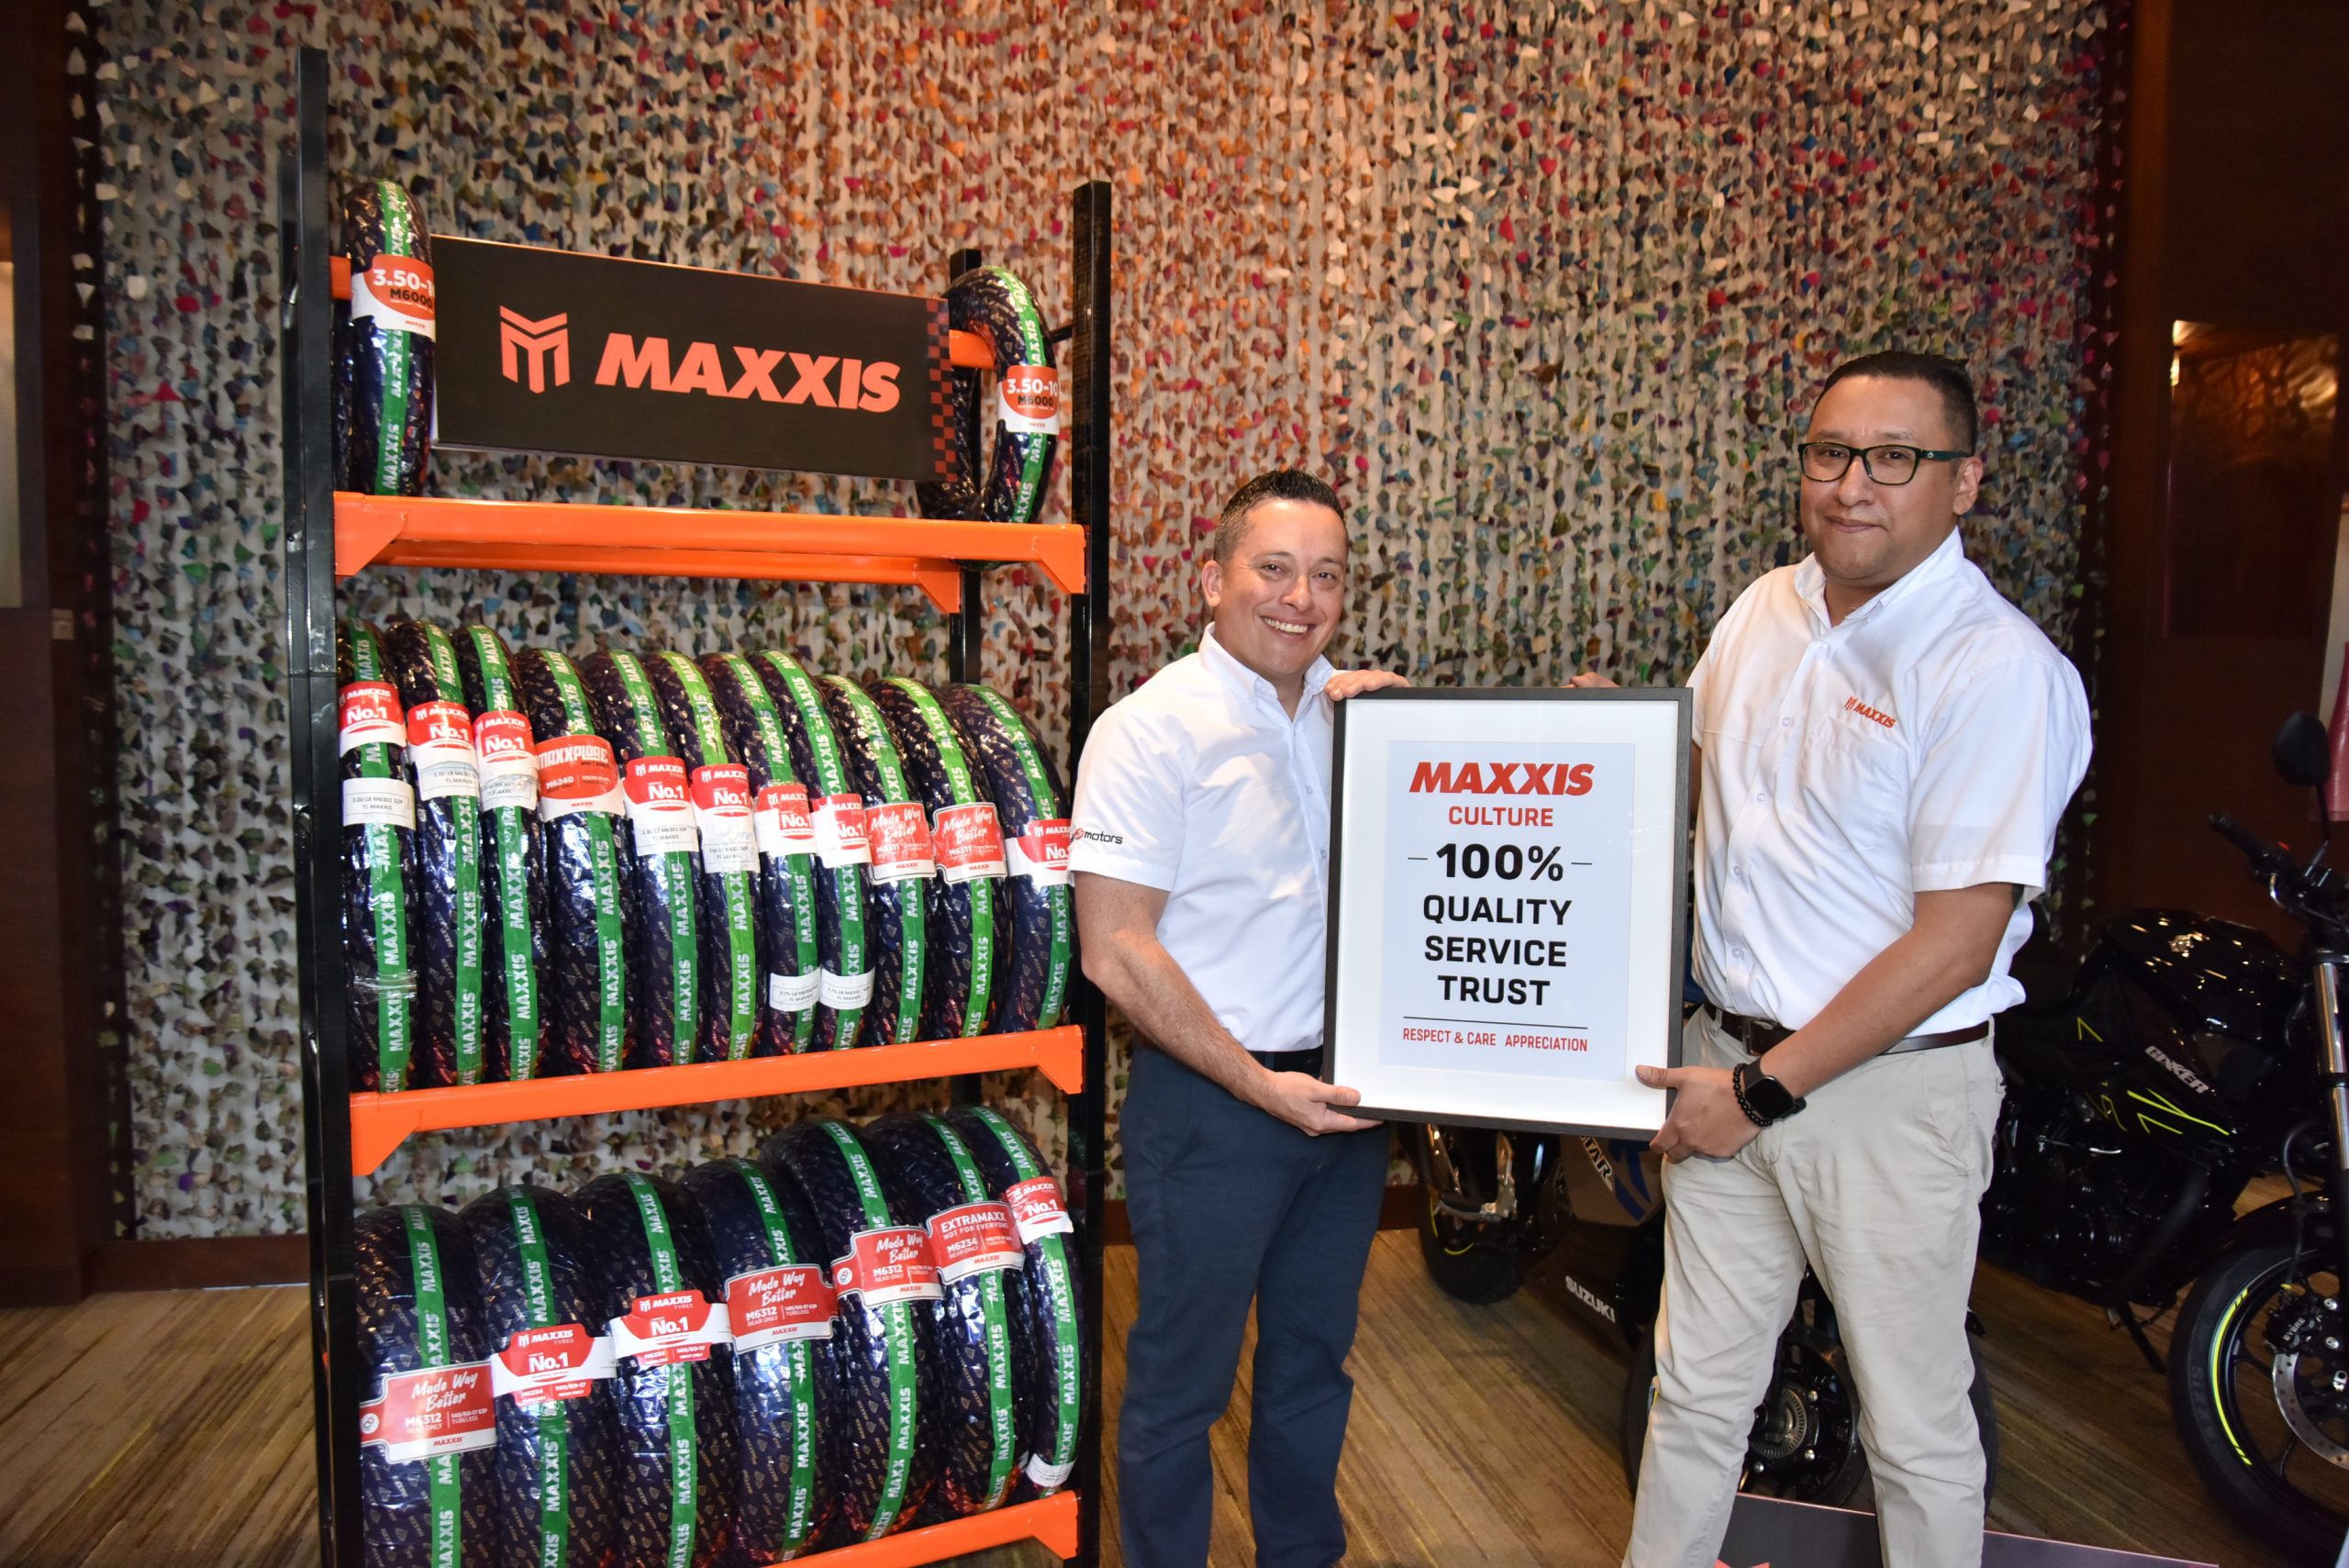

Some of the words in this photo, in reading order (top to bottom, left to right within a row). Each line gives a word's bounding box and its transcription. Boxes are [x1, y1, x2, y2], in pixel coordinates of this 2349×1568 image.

[373, 269, 435, 297] 3.50-1
[390, 287, 433, 309] M6000
[595, 333, 900, 414] MAXXIS
[1007, 378, 1059, 397] 3.50-10
[1018, 395, 1054, 407] M6000
[382, 422, 400, 490] MAXXIS
[1015, 482, 1034, 523] AXXIS
[347, 688, 392, 700] MAXXIS
[347, 706, 388, 725] No.1
[485, 717, 526, 728] MAXXIS
[1854, 702, 1897, 728] MAXXIS
[429, 723, 470, 741] No.1
[484, 736, 526, 753] No.1
[648, 764, 685, 773] MAXXIS
[884, 765, 903, 800] XXIS
[1409, 762, 1595, 795] MAXXIS
[648, 784, 685, 800] No.1
[713, 790, 748, 806] No.1
[952, 767, 971, 803] XXIS
[871, 811, 900, 831] Made
[904, 807, 921, 822] Way
[943, 815, 972, 834] Made
[974, 807, 993, 824] Way
[1046, 827, 1071, 835] MAXX
[1449, 806, 1553, 827] CULTURE
[955, 825, 988, 844] Better
[1084, 830, 1124, 845] motors
[1045, 844, 1070, 860] No.
[1437, 843, 1564, 882] 100%
[596, 839, 615, 915] MAXXIS
[842, 864, 859, 921] MAXX
[671, 862, 690, 936] MAXXIS
[731, 872, 749, 929] MAXX
[795, 873, 813, 943] MAXXIS
[1423, 895, 1573, 926] QUALITY
[380, 891, 400, 965] MAXXIS
[463, 890, 477, 968] MAXXIS
[846, 943, 860, 975] XXIS
[975, 937, 989, 995] MAXXIS
[1425, 936, 1567, 968] SERVICE
[511, 953, 531, 1019] MAXXIS
[604, 940, 618, 1006] MAXXIS
[737, 954, 751, 1015] MAXXIS
[906, 940, 918, 1000] MAXXIS
[678, 960, 692, 1021] MAXXIS
[1046, 962, 1065, 1014] MAXXIS
[1438, 975, 1551, 1006] TRUST
[387, 989, 405, 1051] MAXXIS
[462, 990, 476, 1054] MAXXIS
[899, 1017, 913, 1042] XXIS
[966, 1012, 981, 1037] XXIS
[1402, 1028, 1452, 1044] RESPECT
[1453, 1030, 1464, 1044] &
[1467, 1030, 1497, 1047] CARE
[1505, 1034, 1588, 1051] APPRECIATION
[999, 1129, 1030, 1169] MAXXIS
[850, 1153, 878, 1199] MAXXIS
[1023, 1183, 1054, 1195] MAXXIS
[750, 1176, 777, 1214] MAXXIS
[1026, 1198, 1058, 1217] No.1
[515, 1206, 537, 1244] MAXXIS
[640, 1194, 664, 1233] MAXXIS
[941, 1211, 1007, 1233] EXTRAMAXX
[772, 1229, 791, 1265] XXIS
[876, 1235, 904, 1253] Made
[907, 1232, 923, 1248] Way
[943, 1230, 958, 1240] NOT
[960, 1225, 974, 1234] FOR
[947, 1237, 978, 1253] M6234
[417, 1241, 437, 1293] MAXXIS
[873, 1264, 903, 1277] M6312
[889, 1247, 918, 1263] Better
[974, 1255, 1000, 1263] MAXXIS
[657, 1251, 676, 1293] AXXIS
[749, 1276, 779, 1296] Made
[783, 1271, 805, 1286] Way
[528, 1261, 549, 1322] MAXXIS
[652, 1296, 693, 1308] MAXXIS
[762, 1287, 796, 1307] Better
[1051, 1259, 1071, 1323] MAXXIS
[1565, 1275, 1616, 1323] SUZUKI
[651, 1316, 689, 1336] No.1
[745, 1306, 778, 1321] M6312
[425, 1313, 443, 1365] AXXIS
[531, 1329, 573, 1344] MAXXIS
[772, 1327, 797, 1335] MAXXIS
[893, 1301, 909, 1365] MAXXI
[529, 1351, 569, 1373] No.1
[991, 1323, 1007, 1388] MAXXIS
[411, 1377, 448, 1399] Made
[452, 1371, 478, 1389] Way
[1062, 1343, 1074, 1405] MAXXIS
[425, 1390, 467, 1412] Better
[896, 1386, 911, 1450] MAXXIS
[997, 1408, 1009, 1460] MAXXIS
[433, 1437, 462, 1447] MAXXIS
[796, 1402, 808, 1468] MAXXIS
[545, 1441, 561, 1512] MAXXIS
[676, 1439, 691, 1504] MAXXIS
[789, 1487, 807, 1539] MAXXIS
[439, 1509, 453, 1568] AXXIS
[544, 1533, 560, 1568] XXIS
